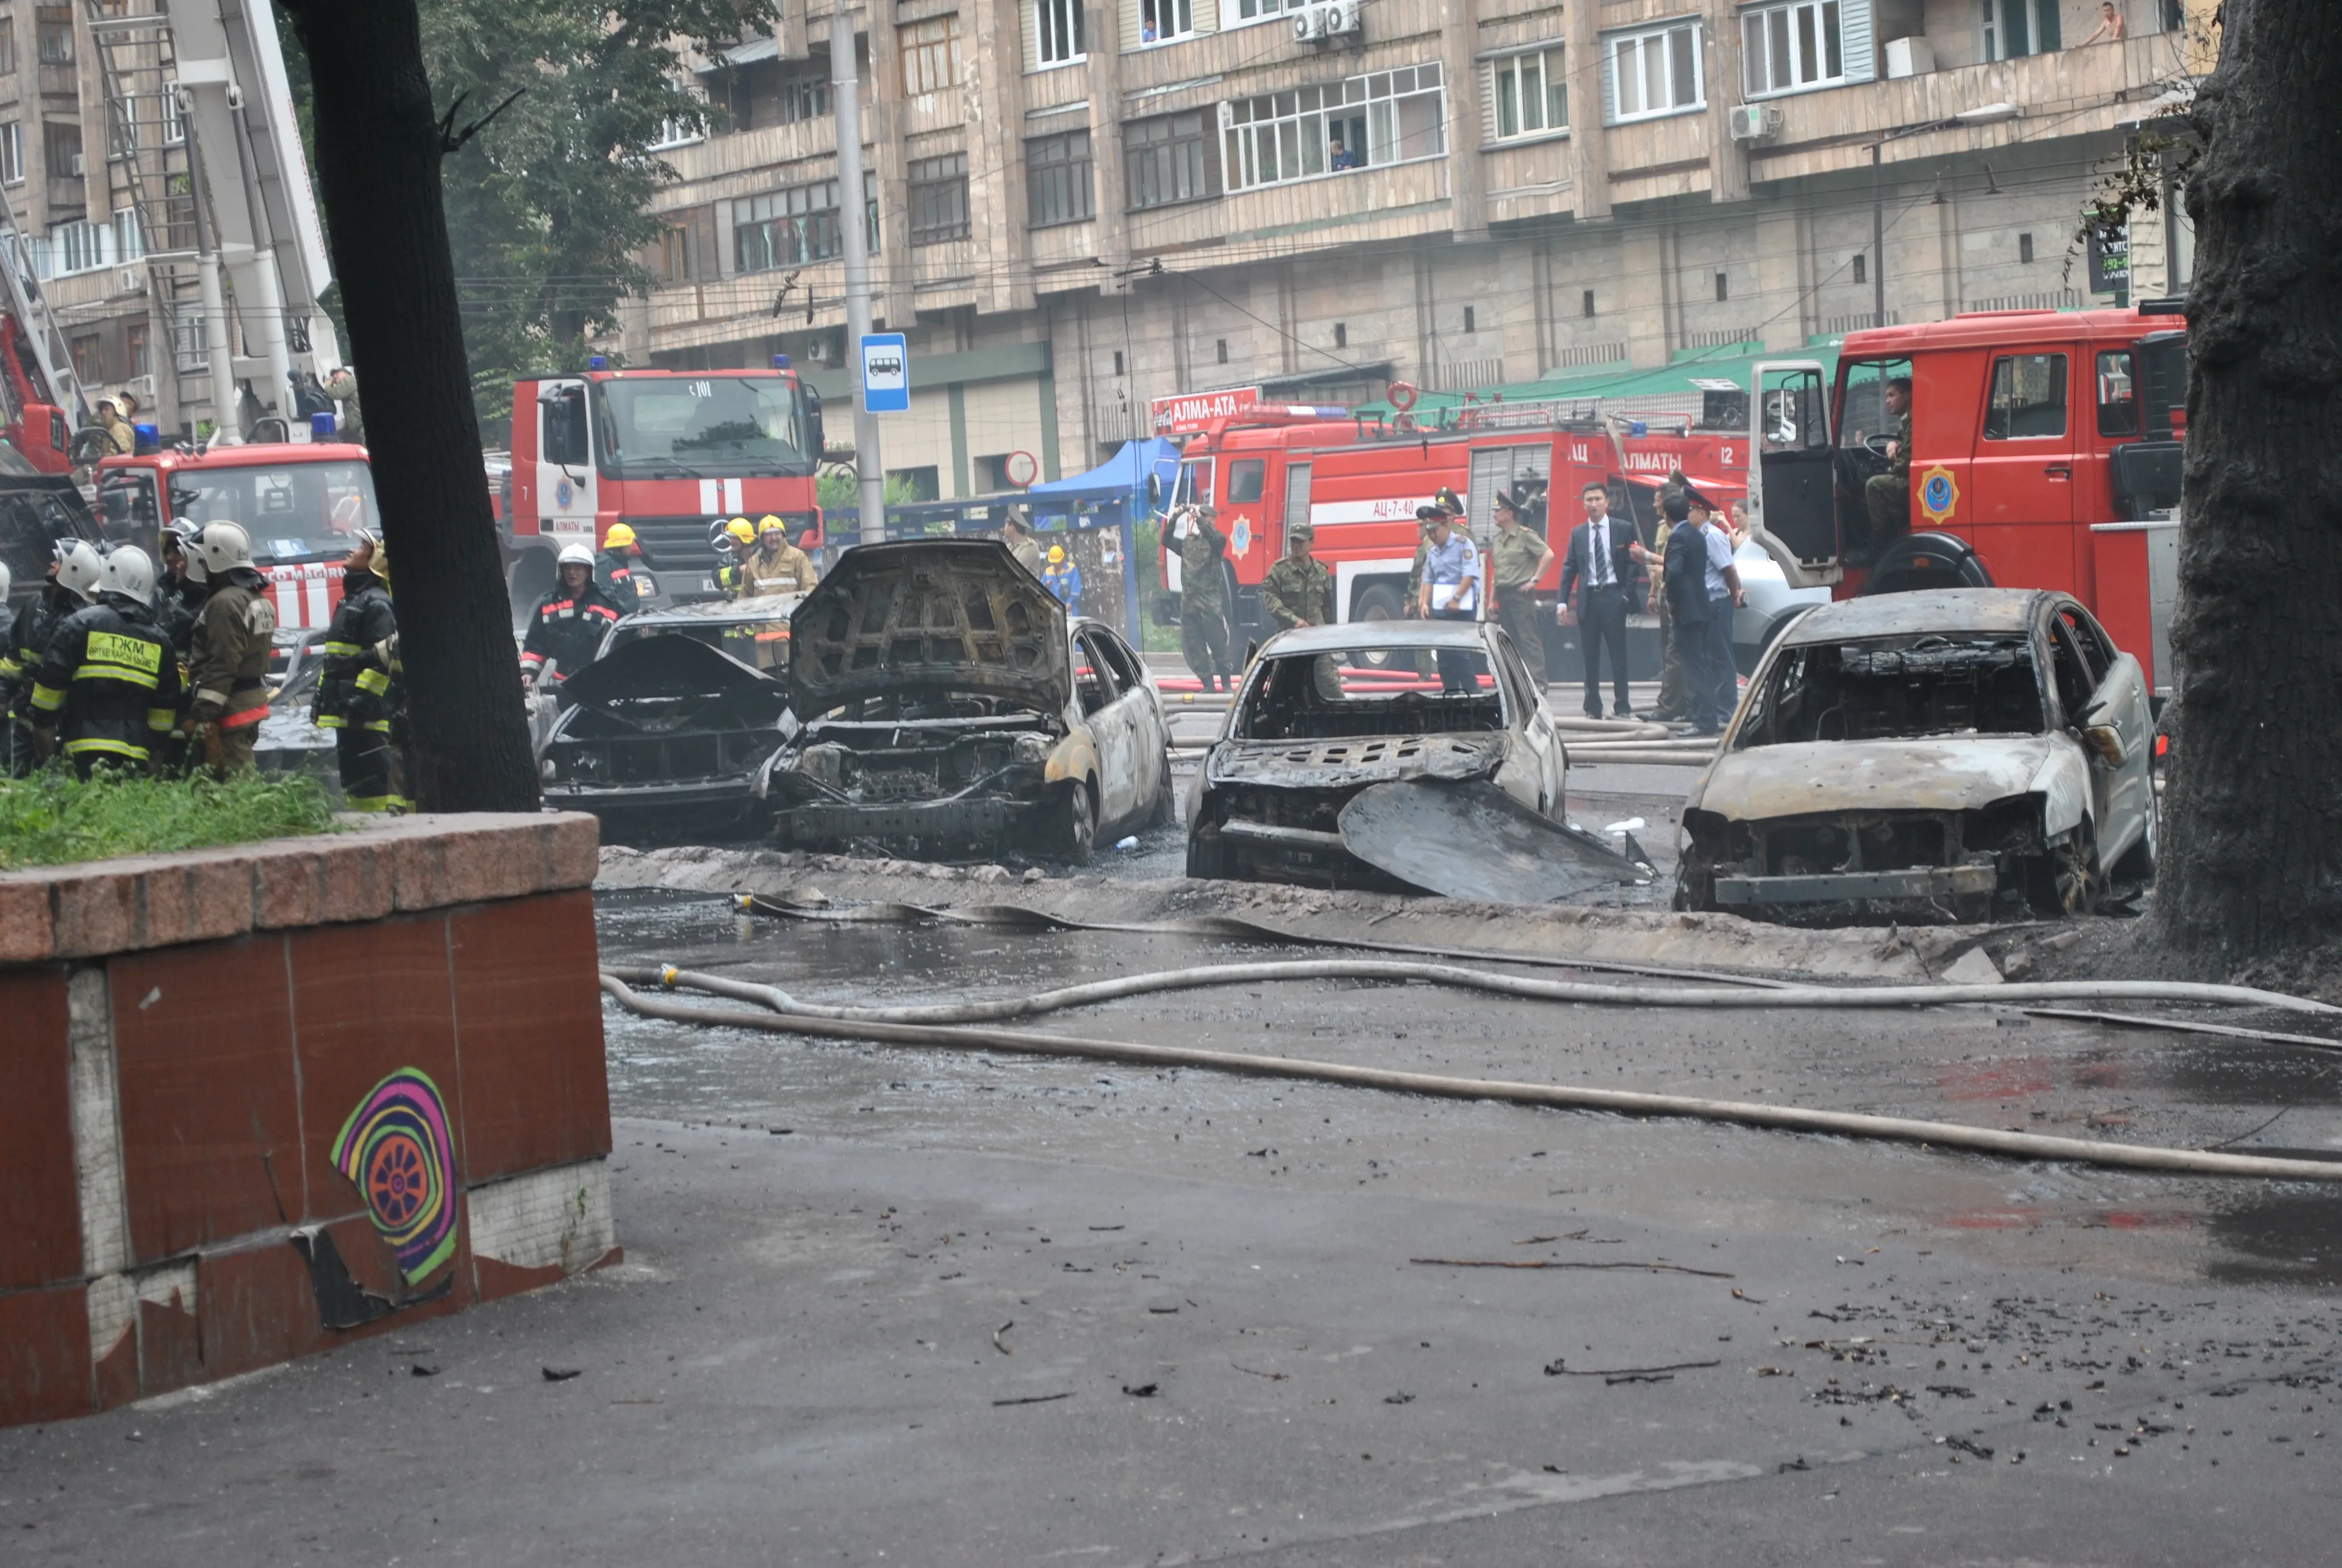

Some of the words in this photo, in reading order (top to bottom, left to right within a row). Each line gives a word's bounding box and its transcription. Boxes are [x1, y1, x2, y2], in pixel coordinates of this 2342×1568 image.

[695, 381, 712, 398] 101
[1173, 395, 1237, 422] АЛМА-АТА
[1619, 452, 1681, 470] АЛМАТЫ
[522, 486, 528, 501] 7
[556, 521, 579, 532] АЛМАТЫ
[109, 635, 145, 656] ТЖМ
